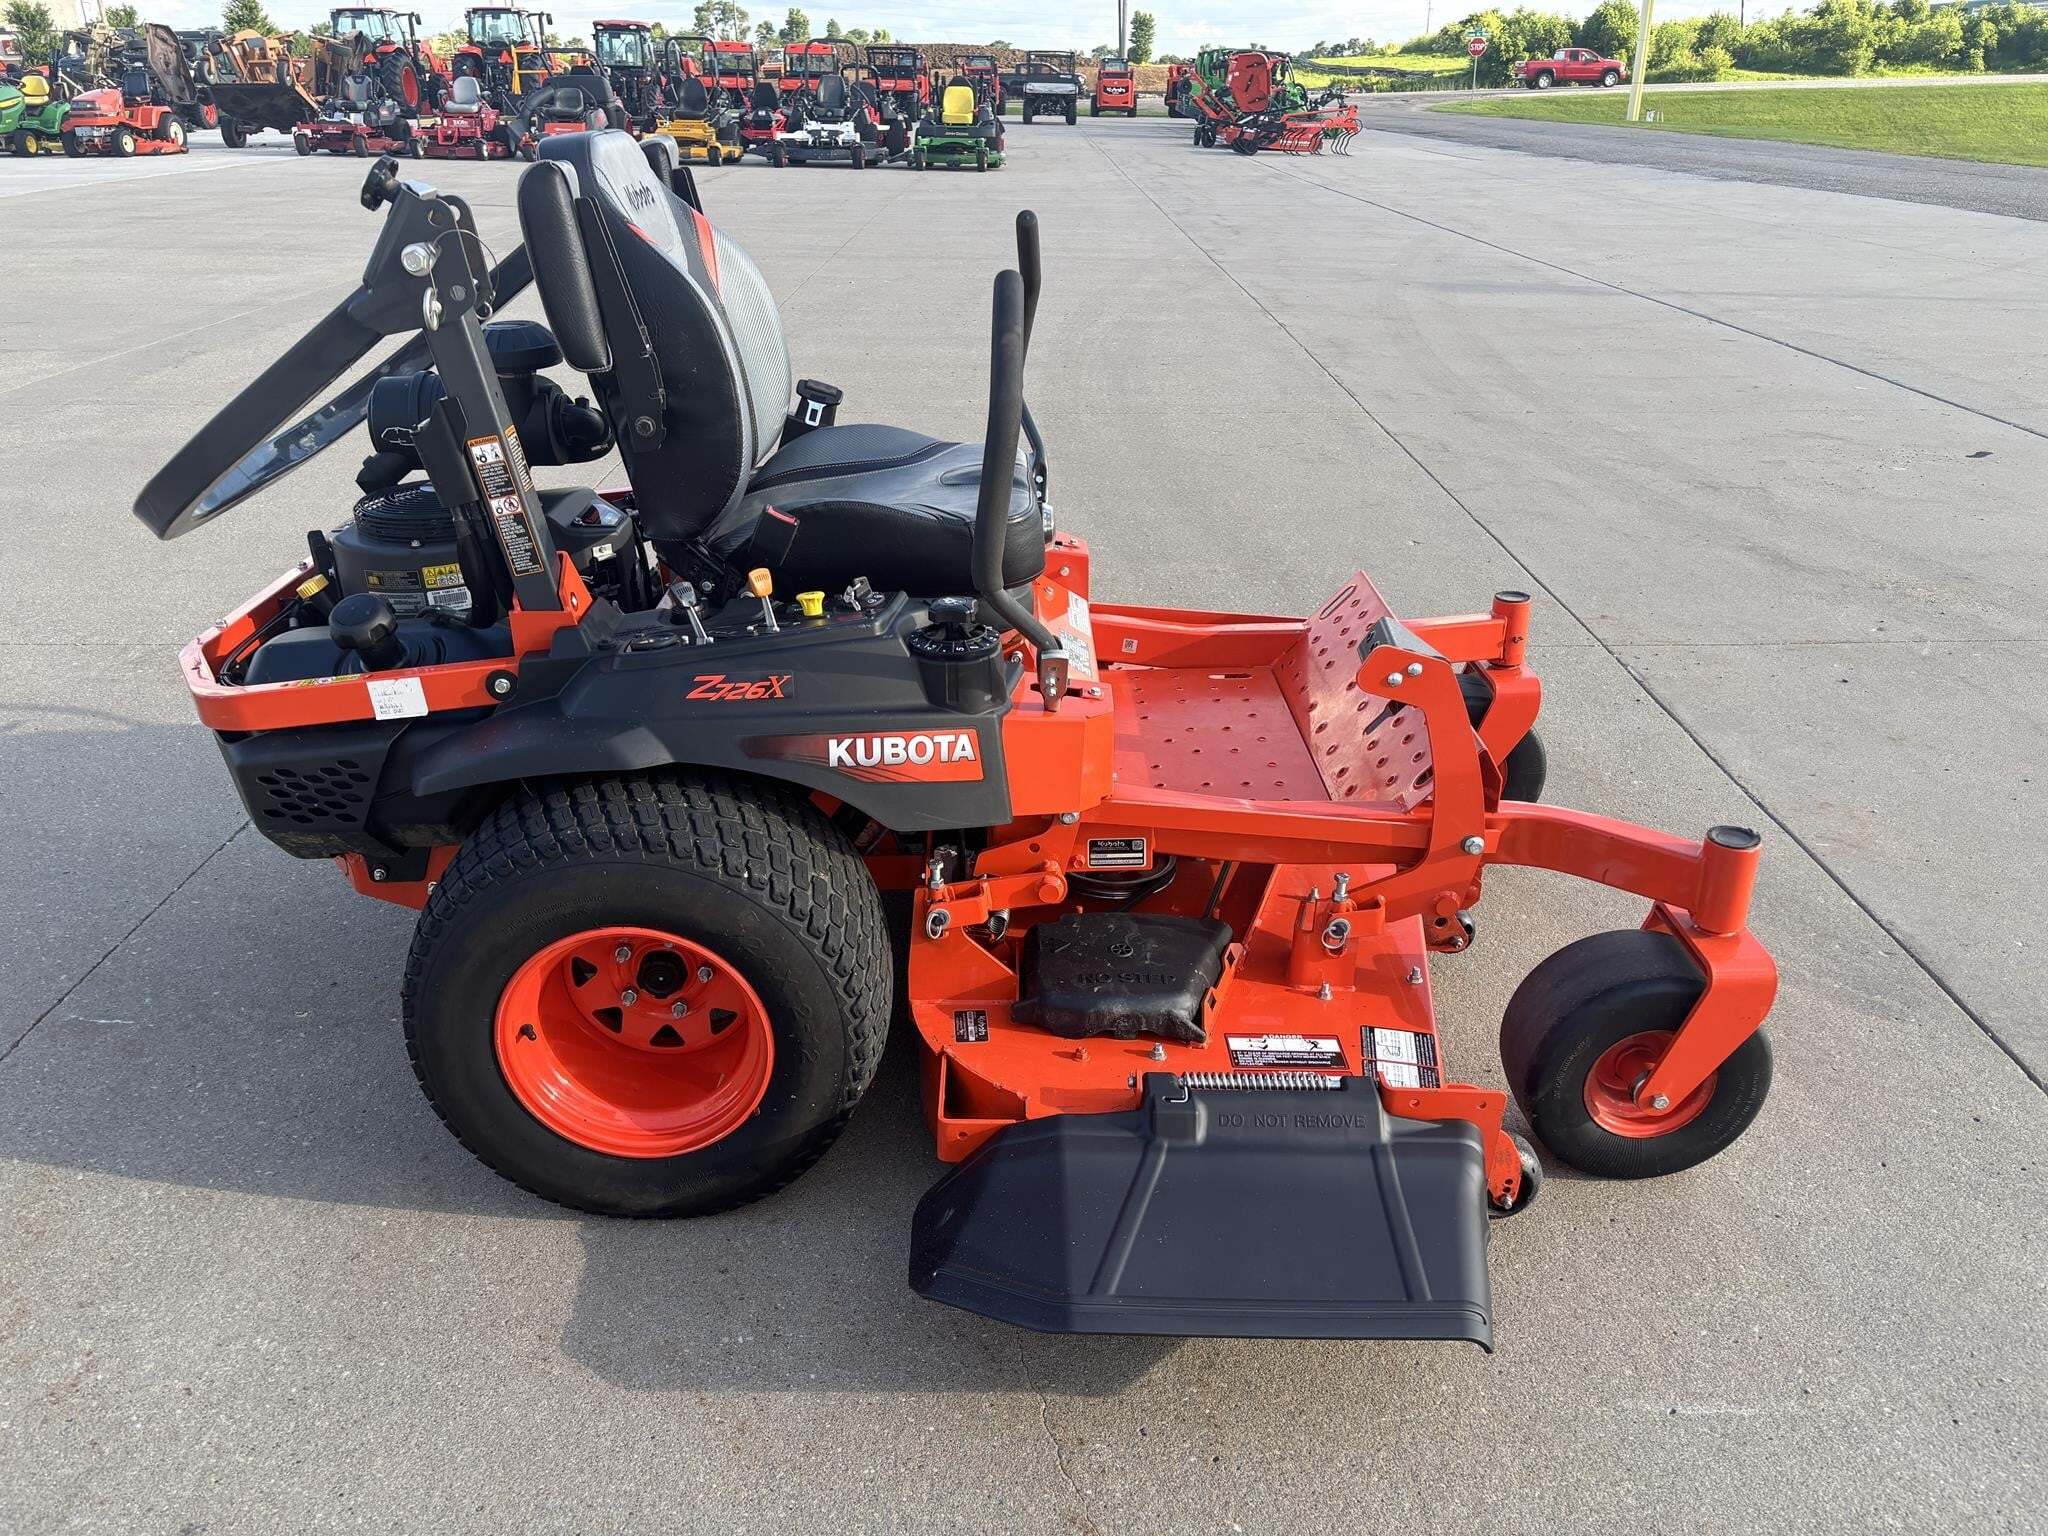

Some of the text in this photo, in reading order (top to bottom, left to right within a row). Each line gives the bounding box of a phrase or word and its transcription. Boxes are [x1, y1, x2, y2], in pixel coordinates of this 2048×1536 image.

[623, 180, 655, 210] Kubota
[686, 674, 792, 701] Z726X
[828, 733, 976, 768] KUBOTA
[1079, 971, 1176, 985] NO STEP
[1218, 1112, 1367, 1129] DO NOT REMOVE
